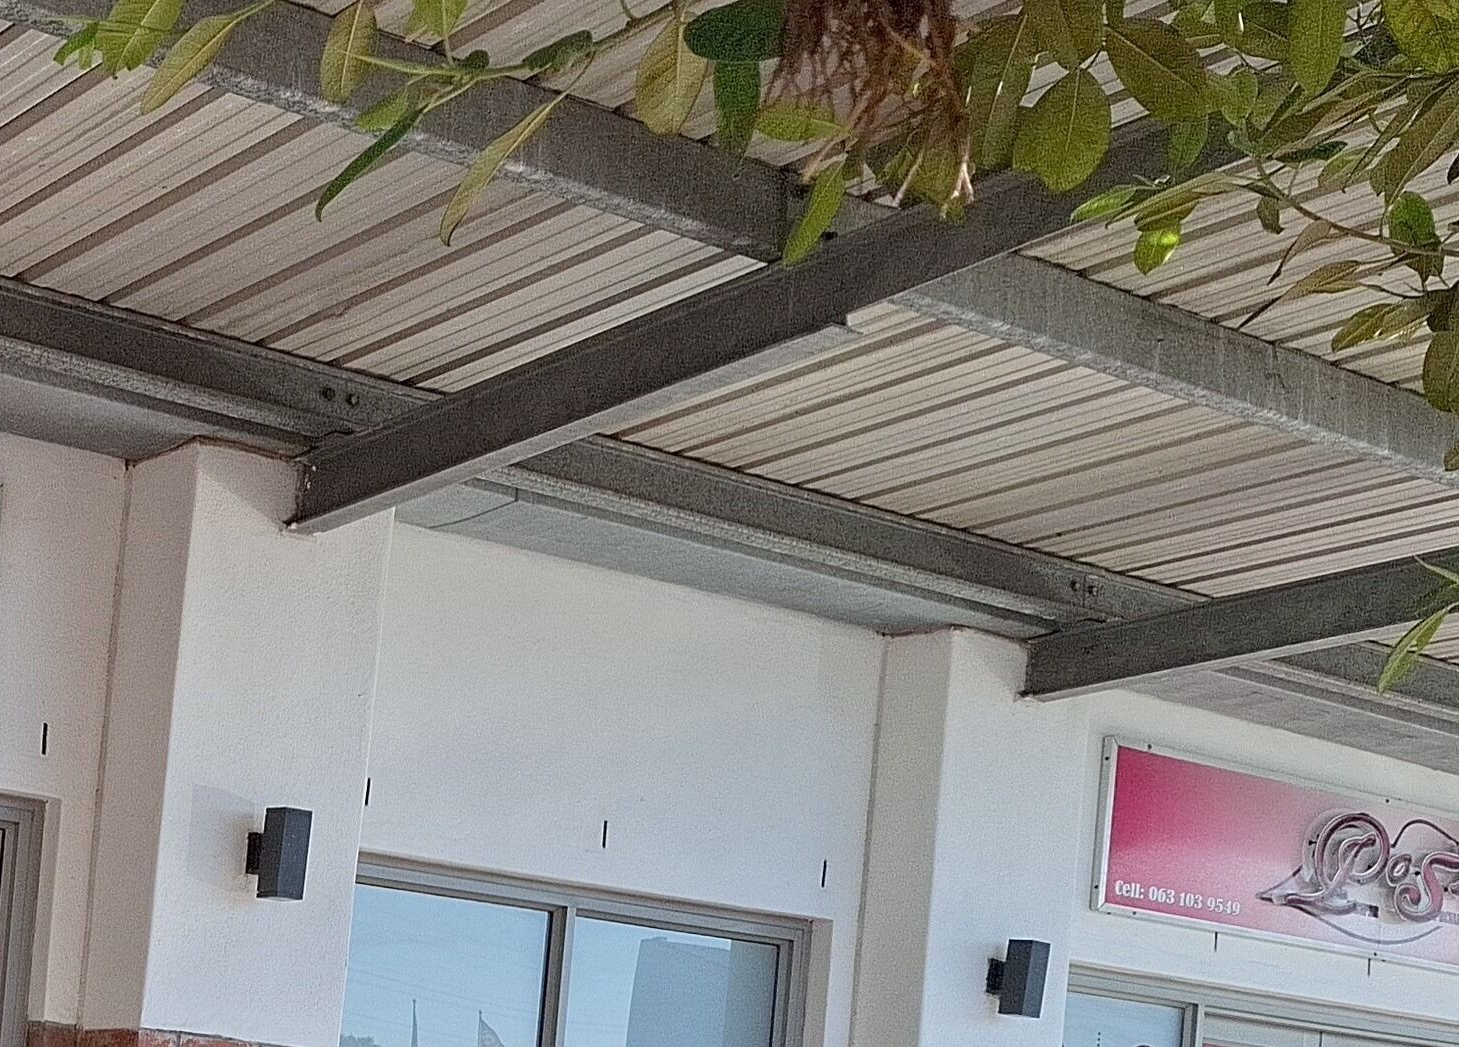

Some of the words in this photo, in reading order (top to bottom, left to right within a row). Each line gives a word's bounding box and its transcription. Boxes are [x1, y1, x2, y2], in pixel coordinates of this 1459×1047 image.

[1114, 879, 1145, 900] Cell:
[1149, 886, 1176, 905] 063
[1179, 891, 1203, 910] 103
[1206, 896, 1241, 916] 9549
